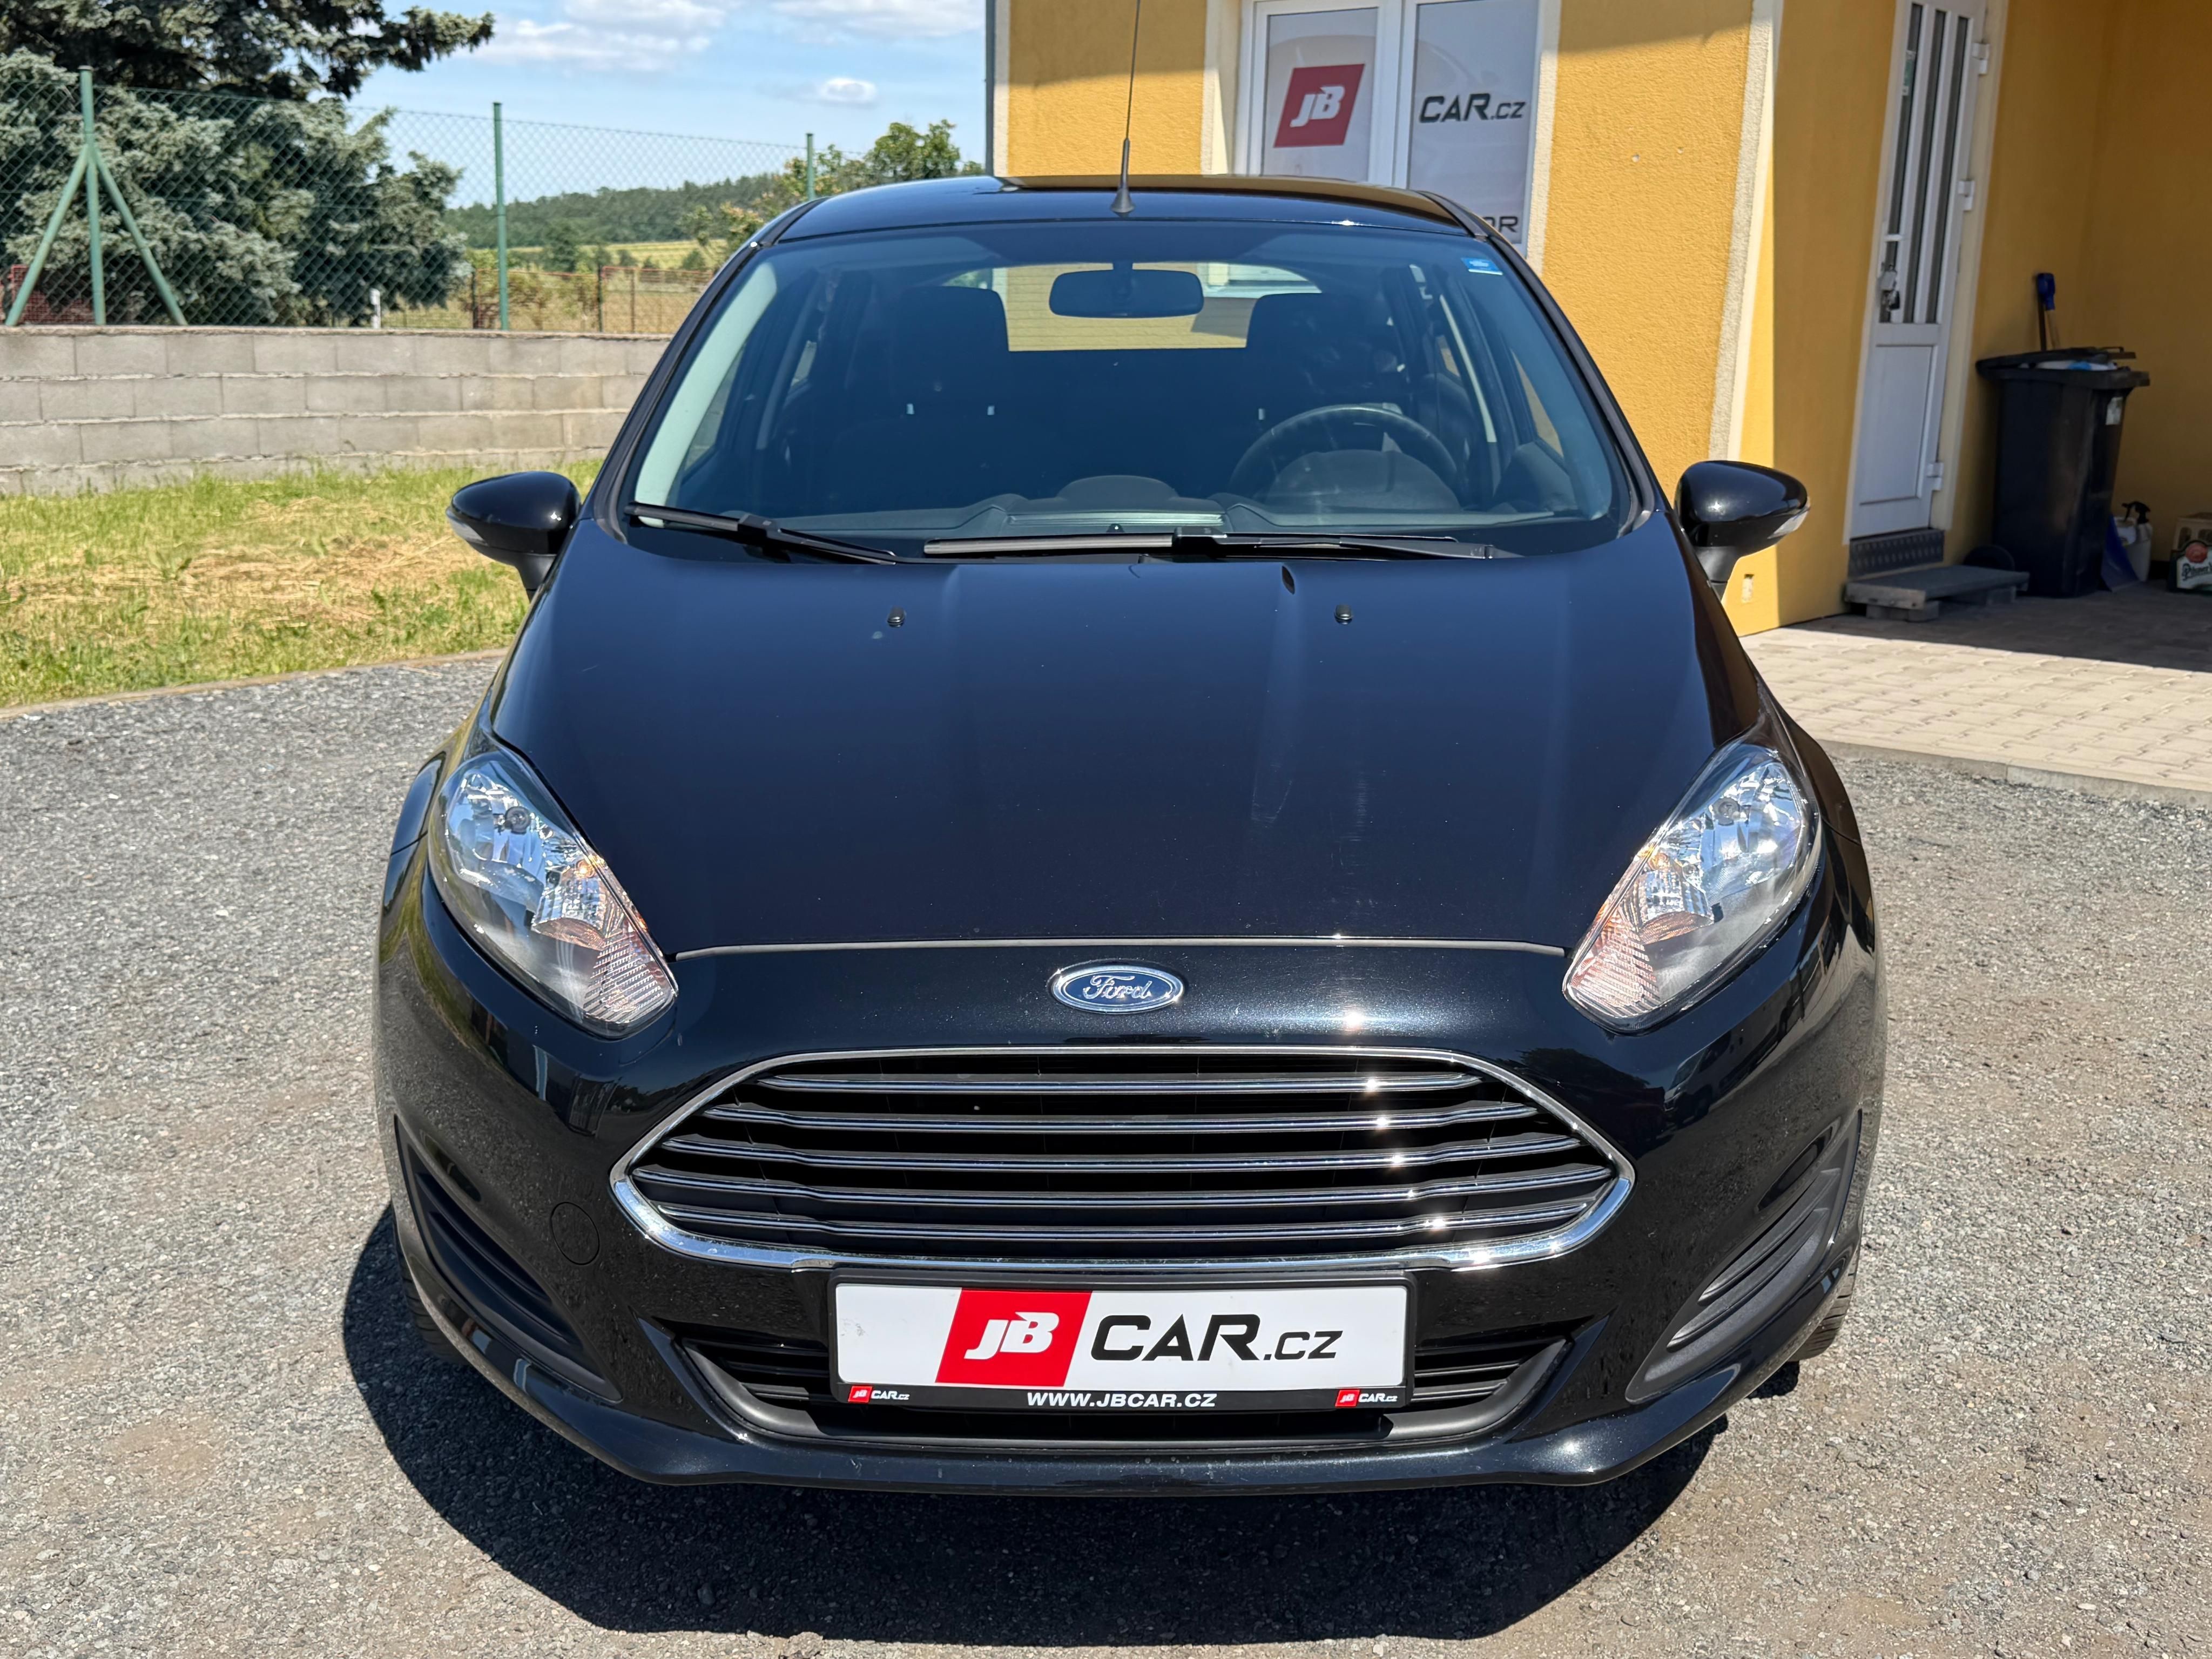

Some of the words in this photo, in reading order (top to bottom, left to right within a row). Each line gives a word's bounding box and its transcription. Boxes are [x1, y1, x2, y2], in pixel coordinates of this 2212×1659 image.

[1290, 85, 1345, 128] JB
[1082, 975, 1152, 999] Ford
[963, 1311, 1060, 1360] JB
[852, 1390, 868, 1398] JB
[1027, 1392, 1217, 1407] WWW.JBCAR.CZ
[1339, 1393, 1354, 1403] JB
